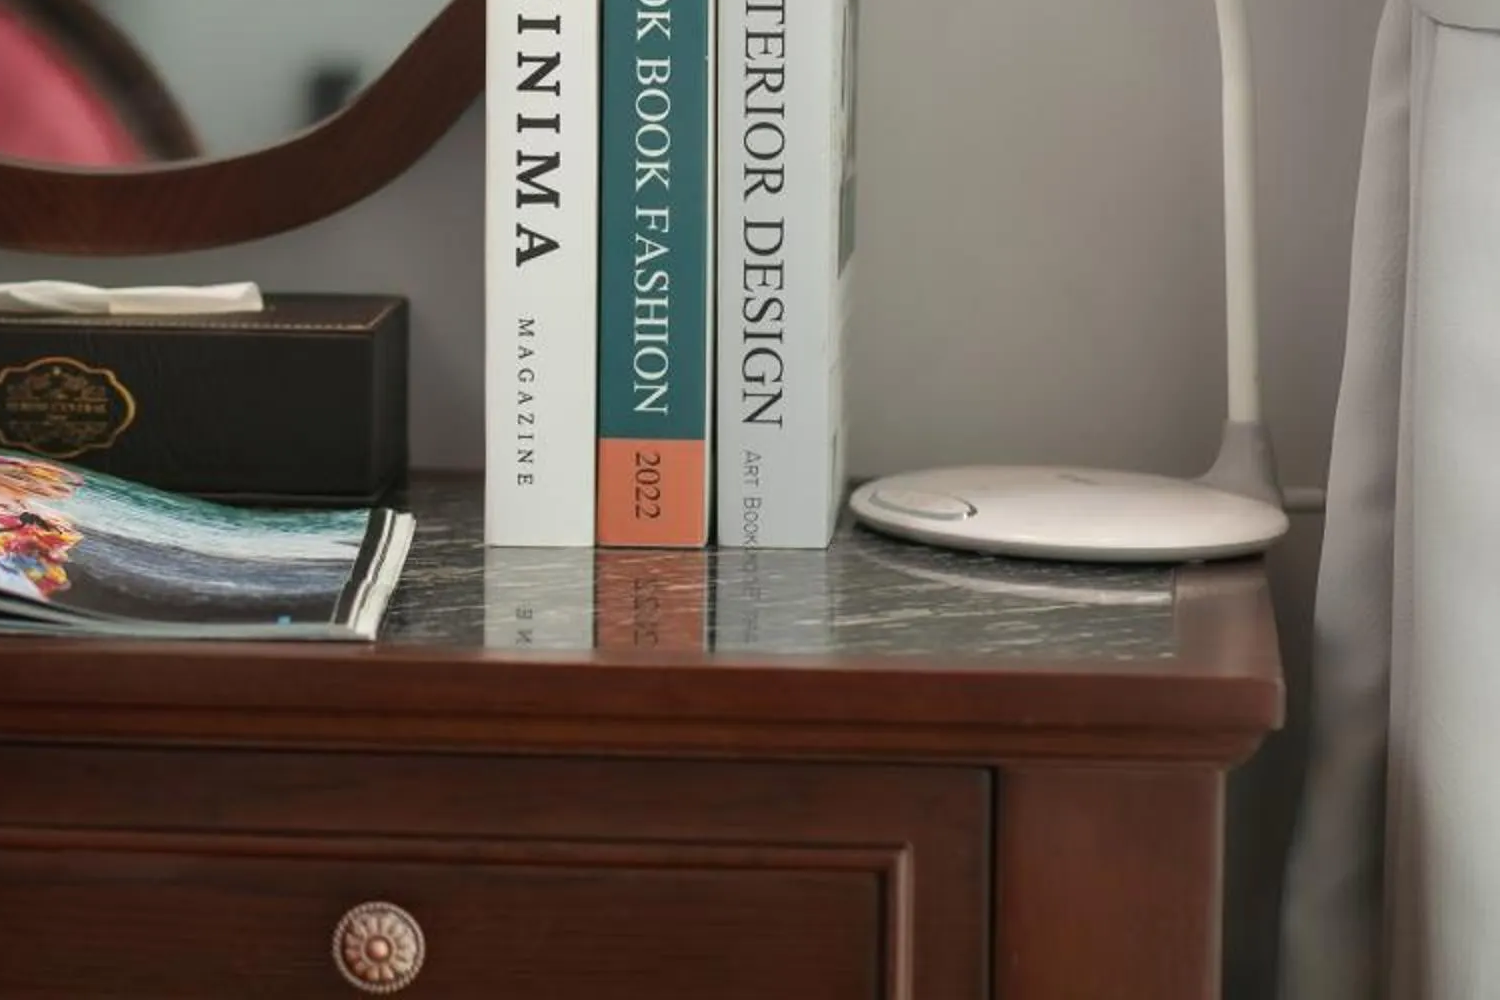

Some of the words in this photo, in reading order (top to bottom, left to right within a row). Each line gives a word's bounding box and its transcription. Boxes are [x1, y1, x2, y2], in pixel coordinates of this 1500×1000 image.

[634, 55, 671, 192] BOOK
[633, 205, 670, 416] FASHION
[741, 215, 785, 429] DESIGN
[516, 317, 536, 486] MAGAZINE
[634, 451, 662, 520] 2022
